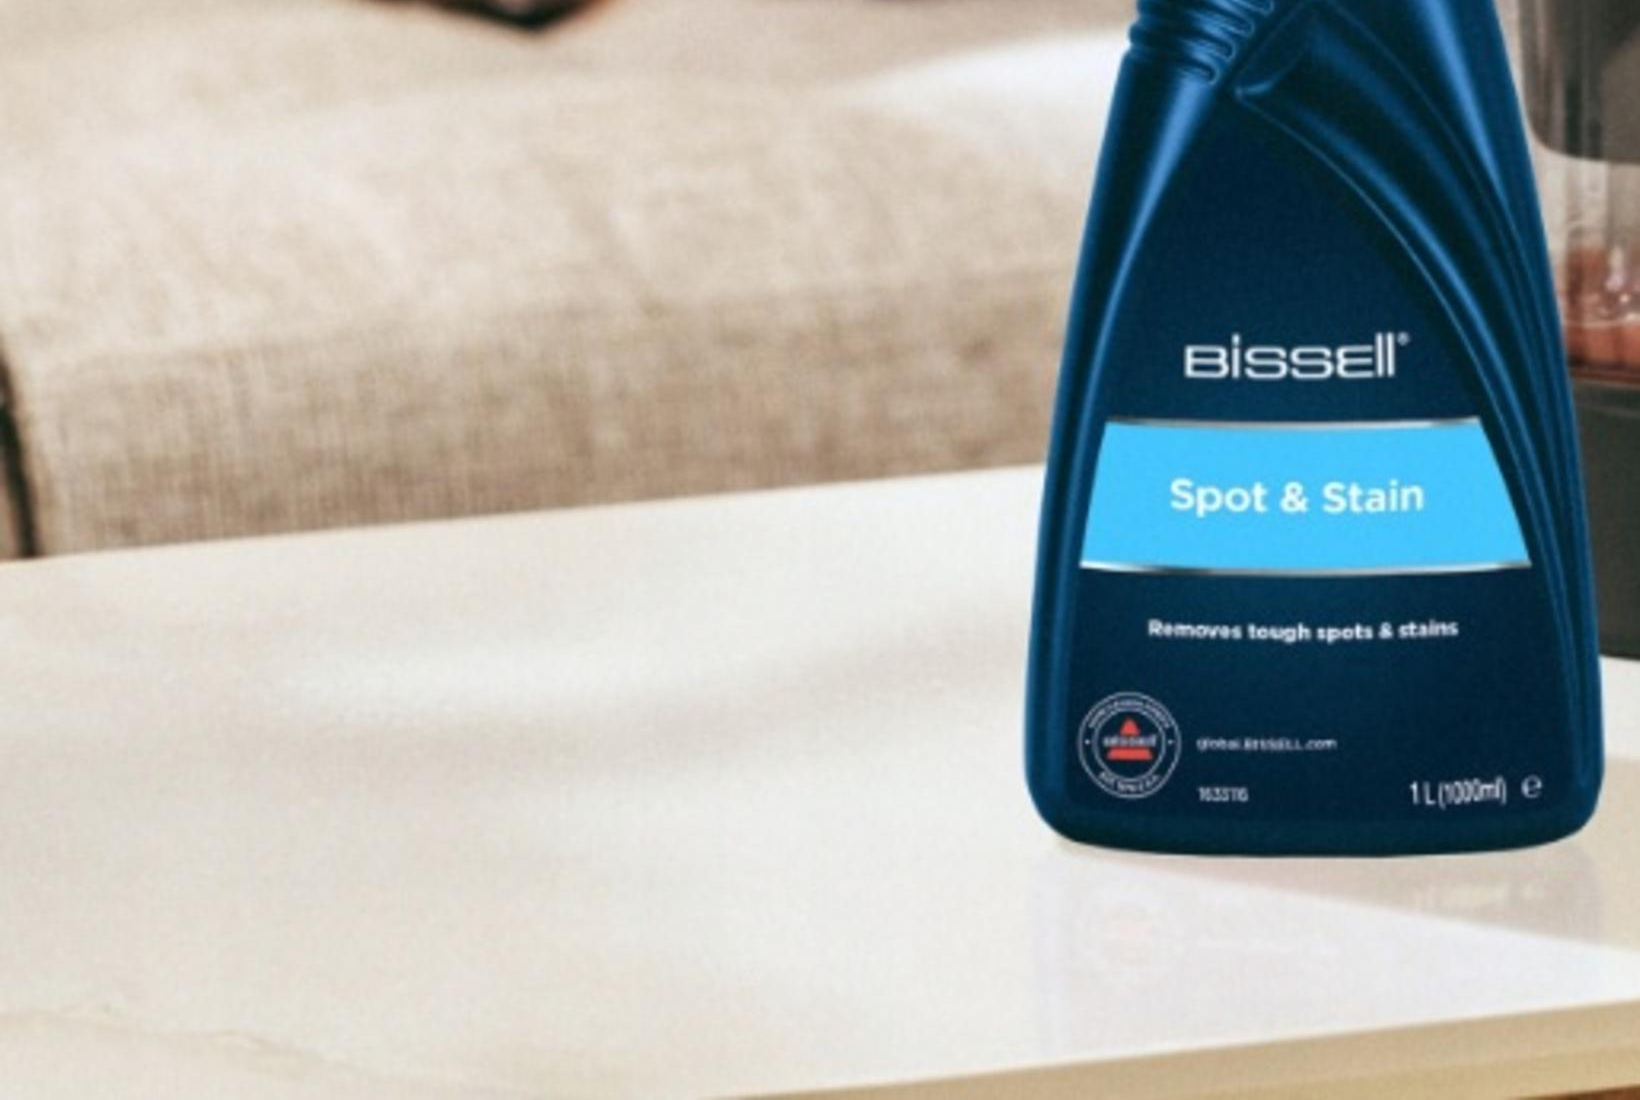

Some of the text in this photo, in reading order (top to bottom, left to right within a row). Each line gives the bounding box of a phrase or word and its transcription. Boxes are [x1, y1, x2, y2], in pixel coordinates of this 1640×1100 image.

[1169, 477, 1425, 518] Spot & Stain
[1147, 618, 1460, 644] Removes tough spots & stains
